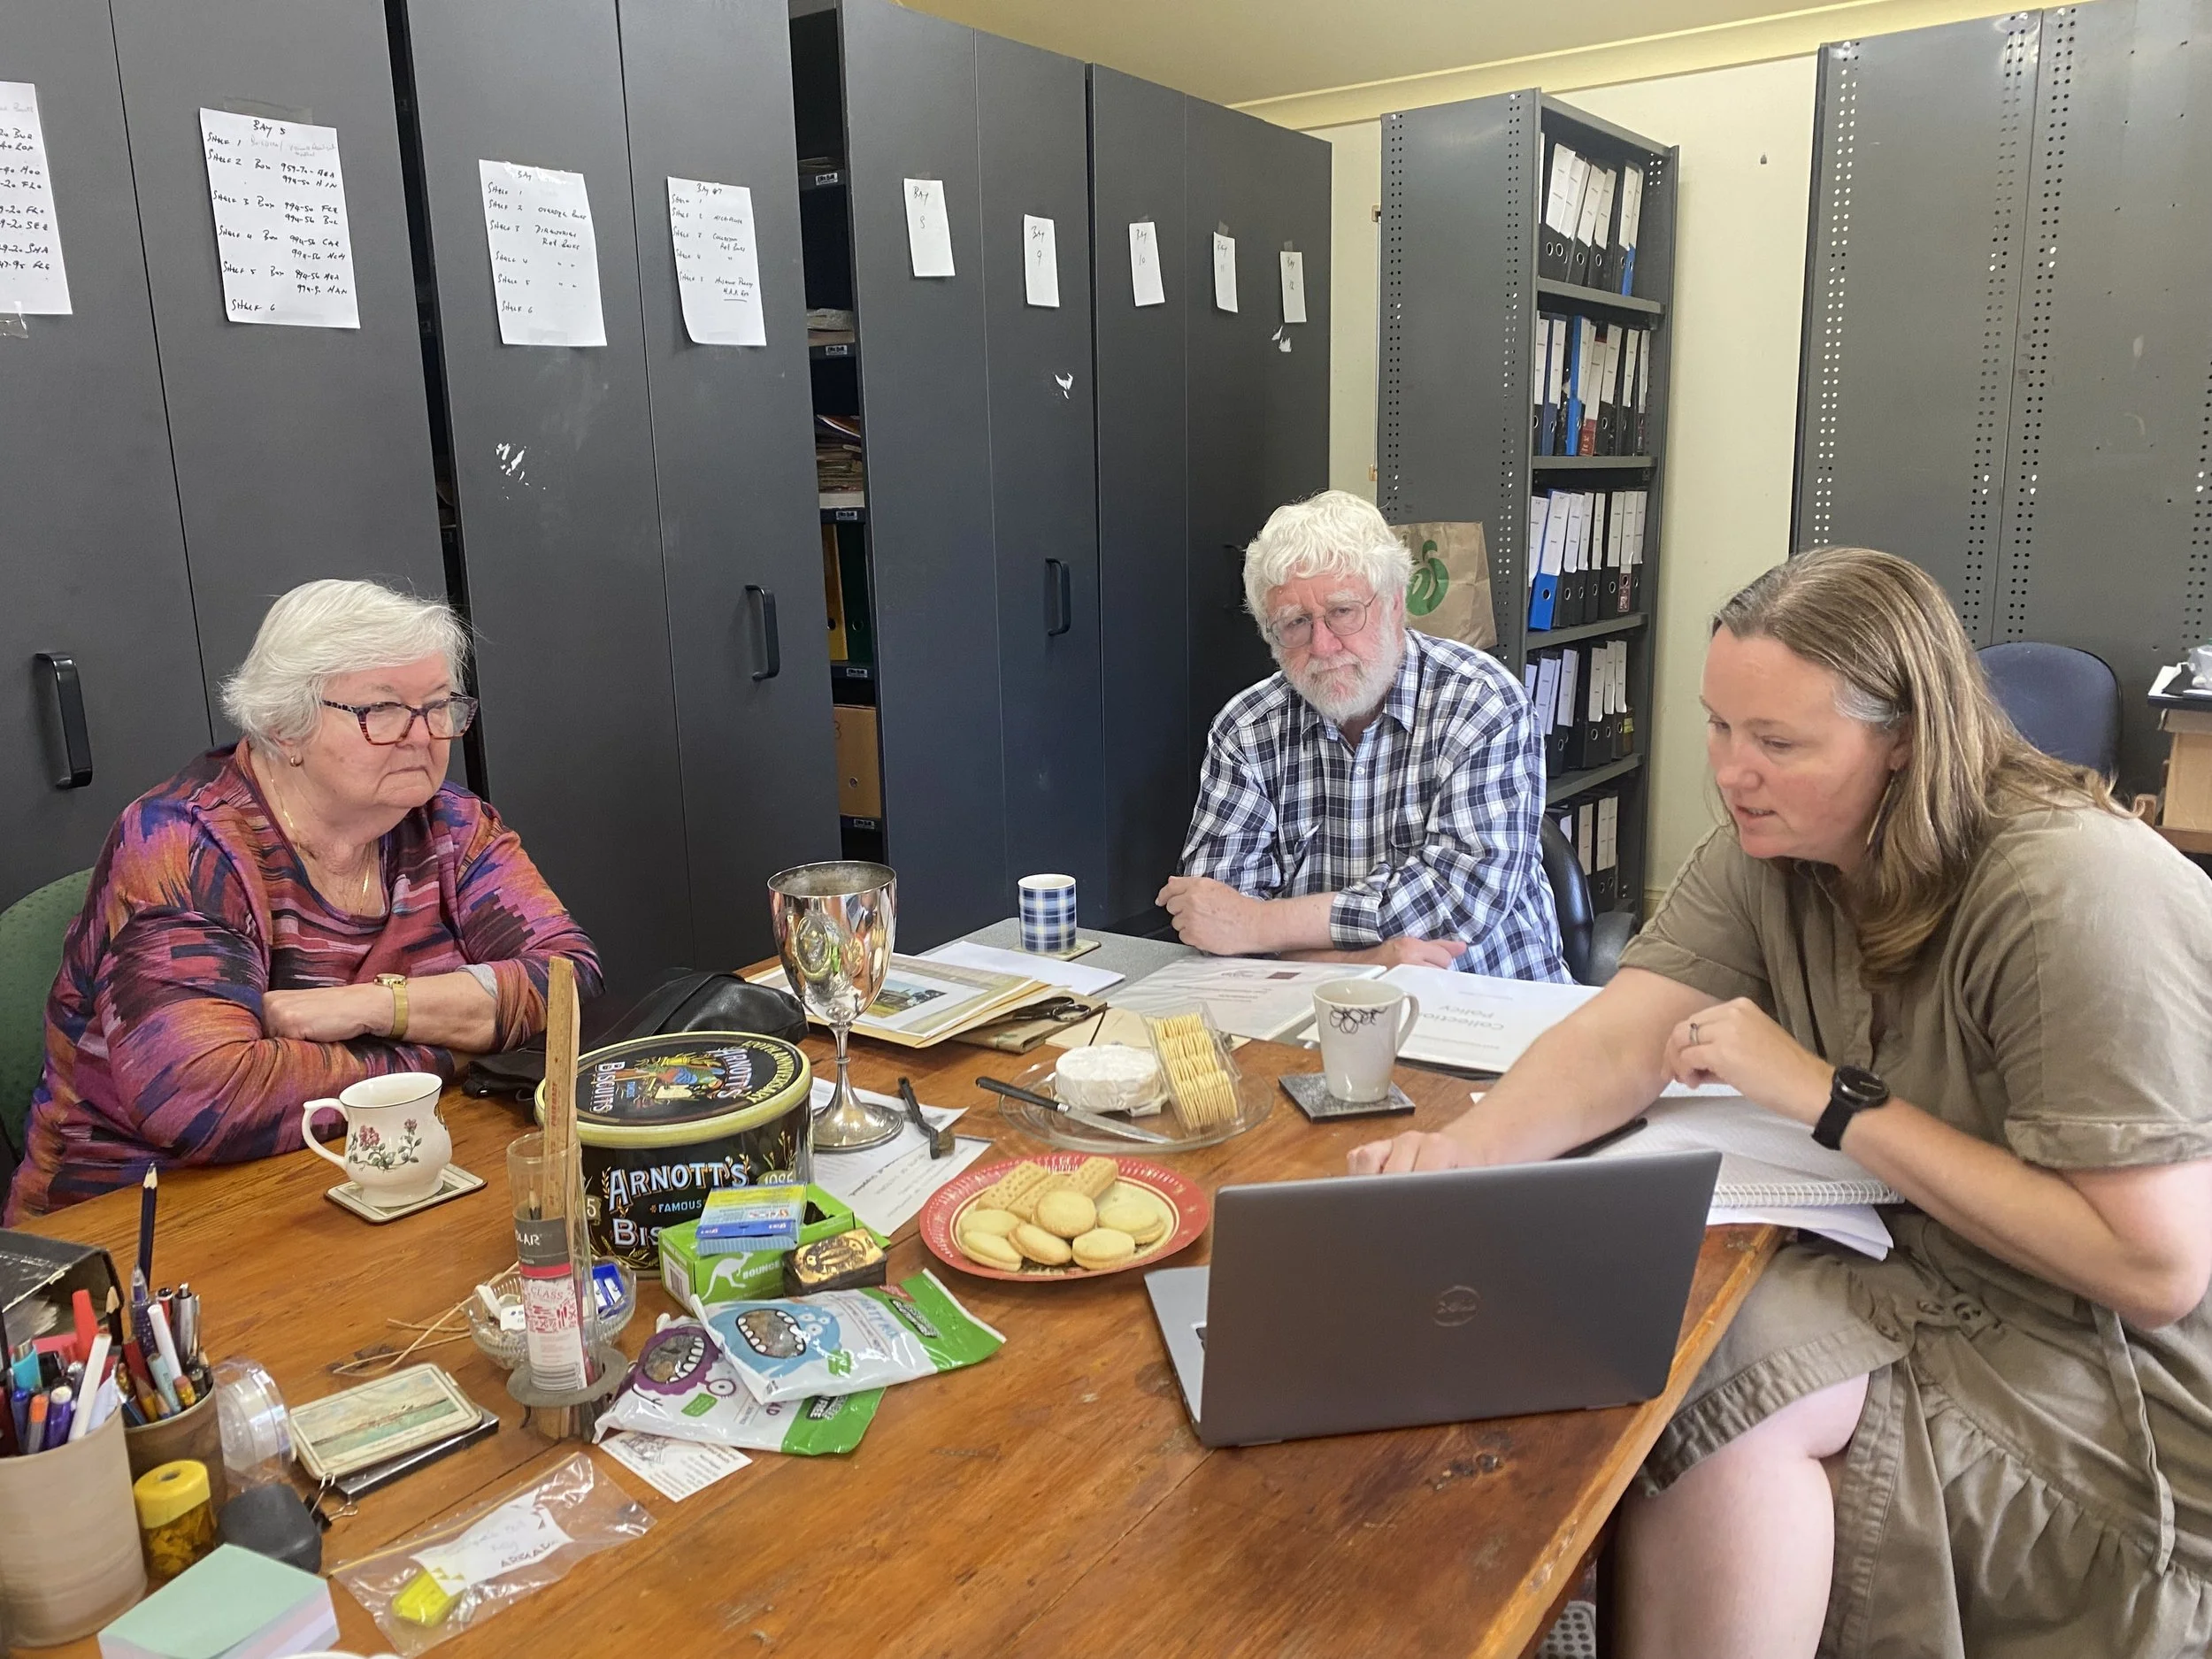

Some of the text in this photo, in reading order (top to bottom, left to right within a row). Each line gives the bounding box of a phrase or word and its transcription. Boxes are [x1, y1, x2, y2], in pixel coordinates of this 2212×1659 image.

[1036, 250, 1042, 266] 9
[1419, 1012, 1505, 1032] Collectio
[594, 1061, 626, 1113] BISCUITS
[608, 1155, 749, 1214] ARNOTT'S
[658, 1201, 703, 1213] FAMOUS
[611, 1217, 661, 1249] BIS
[742, 1261, 780, 1280] BOUNCE
